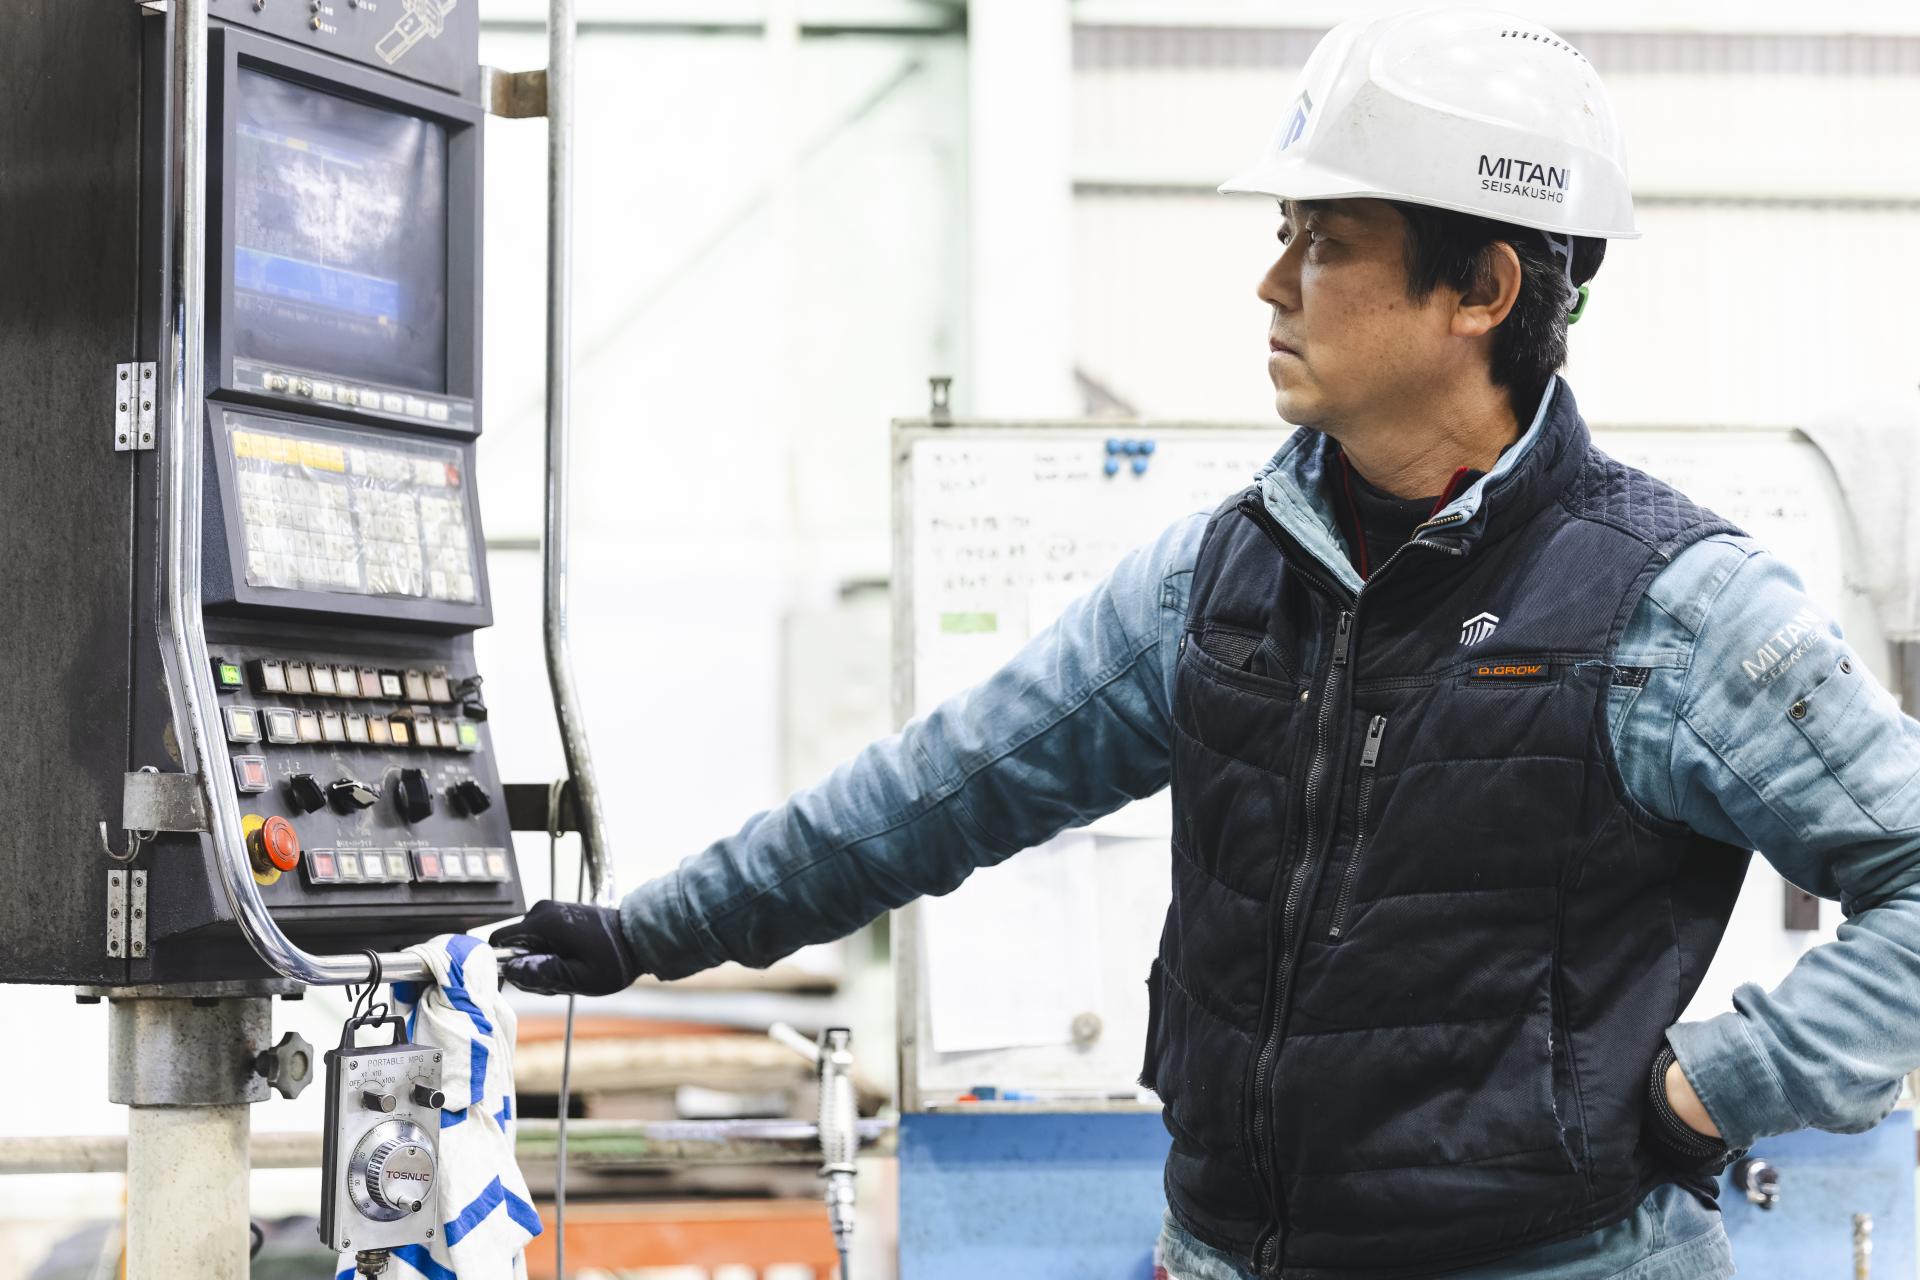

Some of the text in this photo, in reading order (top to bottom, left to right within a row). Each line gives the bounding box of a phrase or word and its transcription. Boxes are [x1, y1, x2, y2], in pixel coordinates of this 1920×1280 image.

[1478, 154, 1570, 191] MITANI
[1481, 179, 1564, 204] SEISAKUSHO
[1741, 607, 1822, 681] MITAN
[1761, 626, 1826, 685] SEISAKUS
[367, 1055, 424, 1067] PORTABLE MPG
[386, 1170, 430, 1182] TOSNUC
